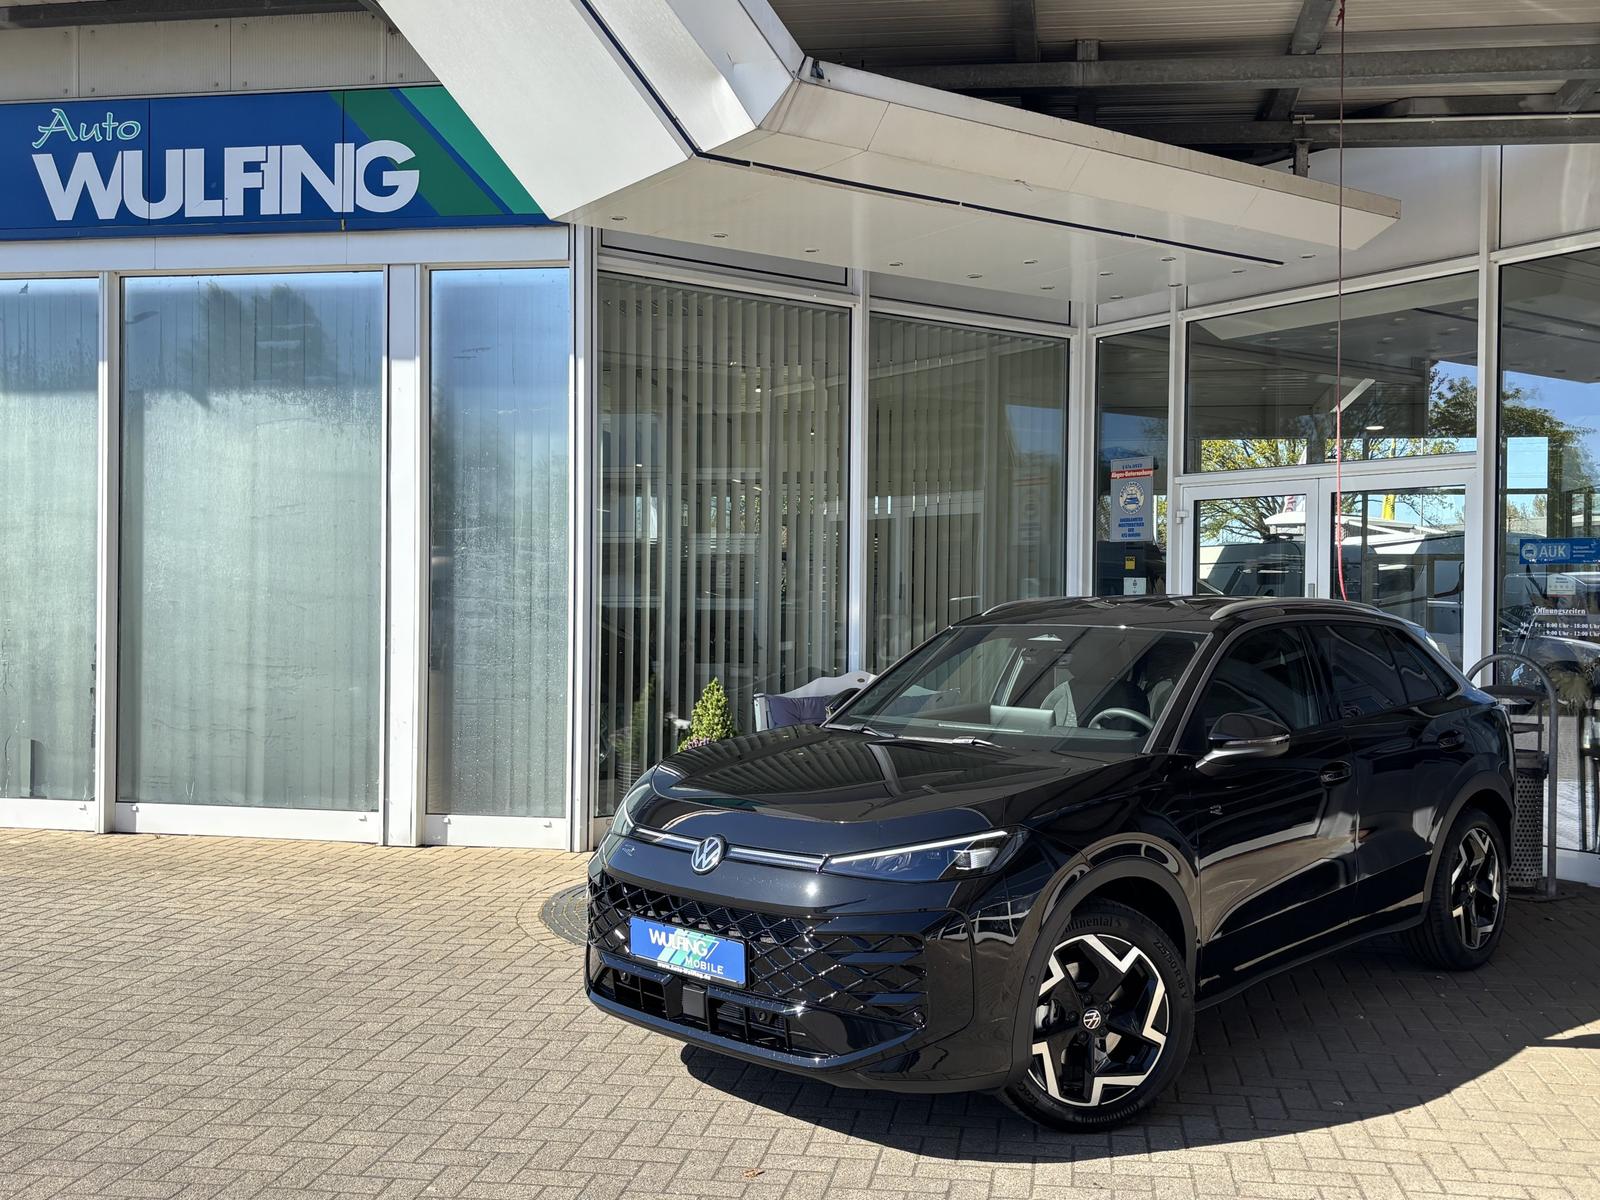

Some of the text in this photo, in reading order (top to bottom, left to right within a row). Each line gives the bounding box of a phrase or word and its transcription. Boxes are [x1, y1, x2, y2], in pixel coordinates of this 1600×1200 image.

[32, 108, 142, 149] Auto
[31, 139, 421, 221] WULFING
[1539, 545, 1566, 557] AUK
[1534, 606, 1586, 615] Öffnungszeiten
[649, 928, 708, 957] WULFING
[684, 957, 724, 975] MOBILE
